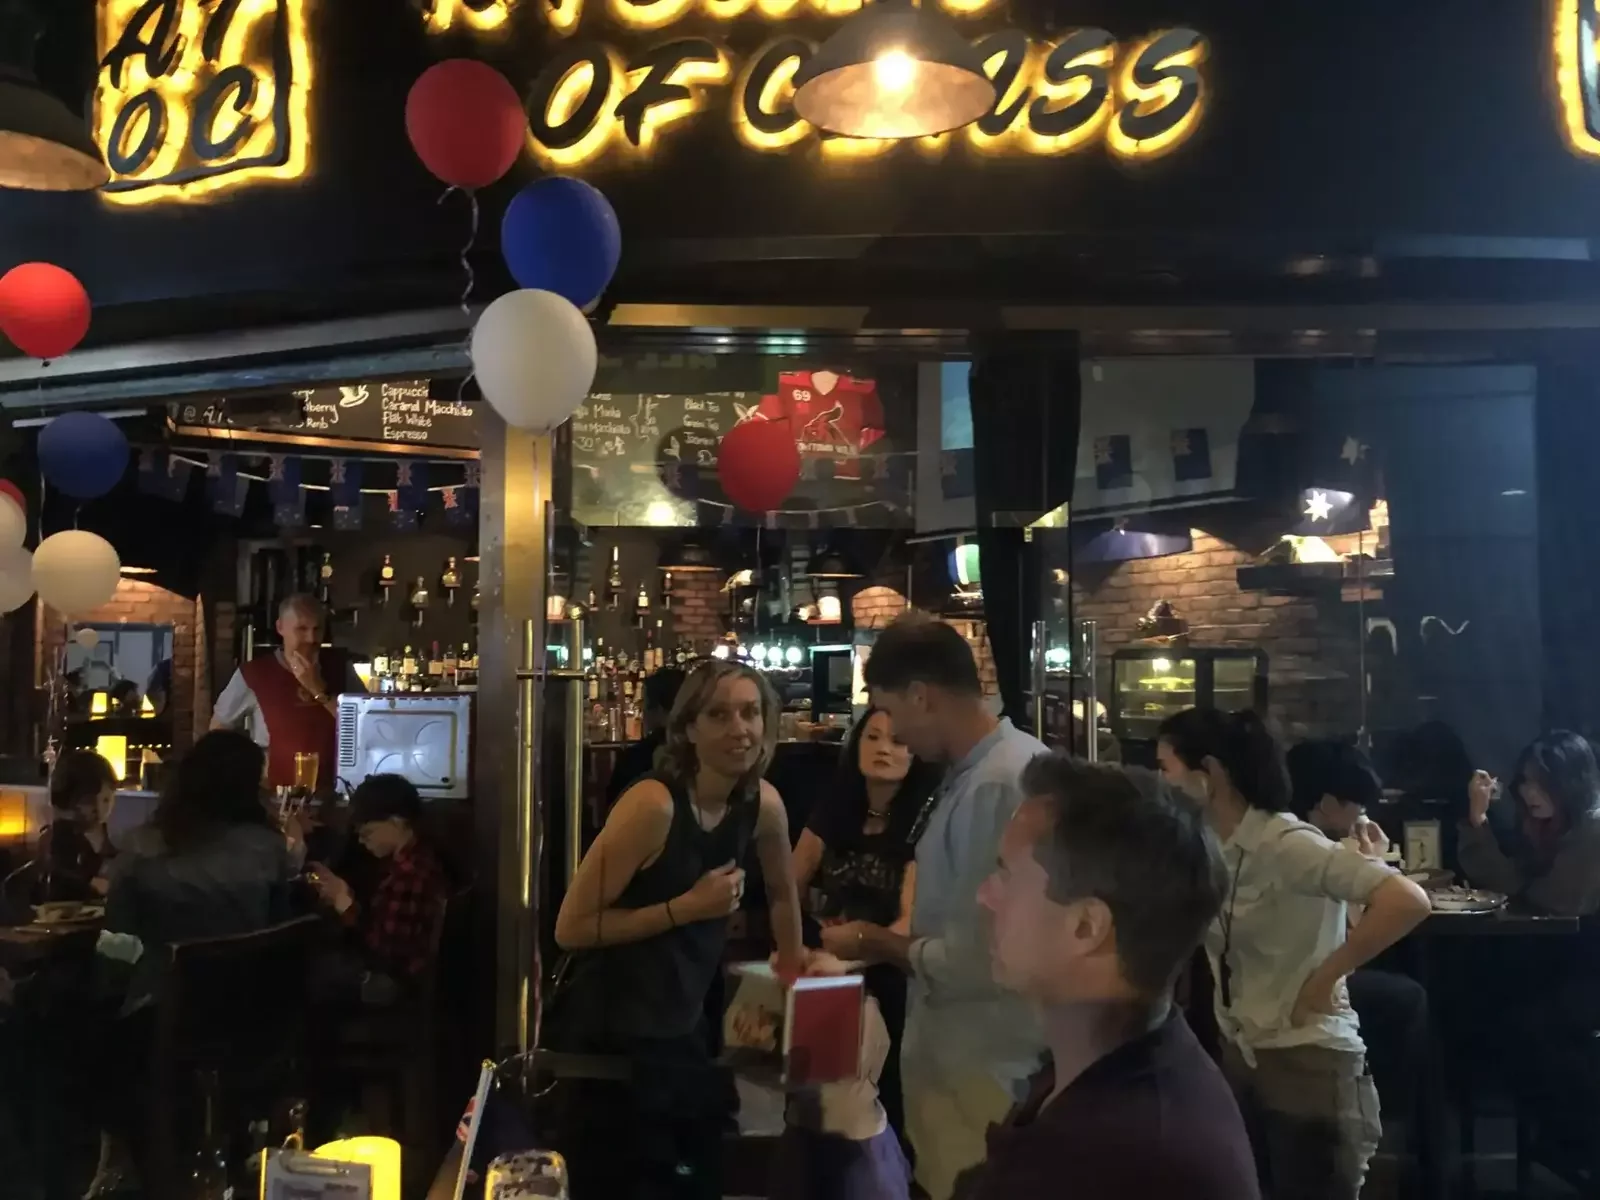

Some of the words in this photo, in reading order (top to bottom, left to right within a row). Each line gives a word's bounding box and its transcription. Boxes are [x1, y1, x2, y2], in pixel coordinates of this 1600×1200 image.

[527, 36, 720, 150] OF
[792, 389, 811, 402] 69
[383, 426, 428, 441] Espresso
